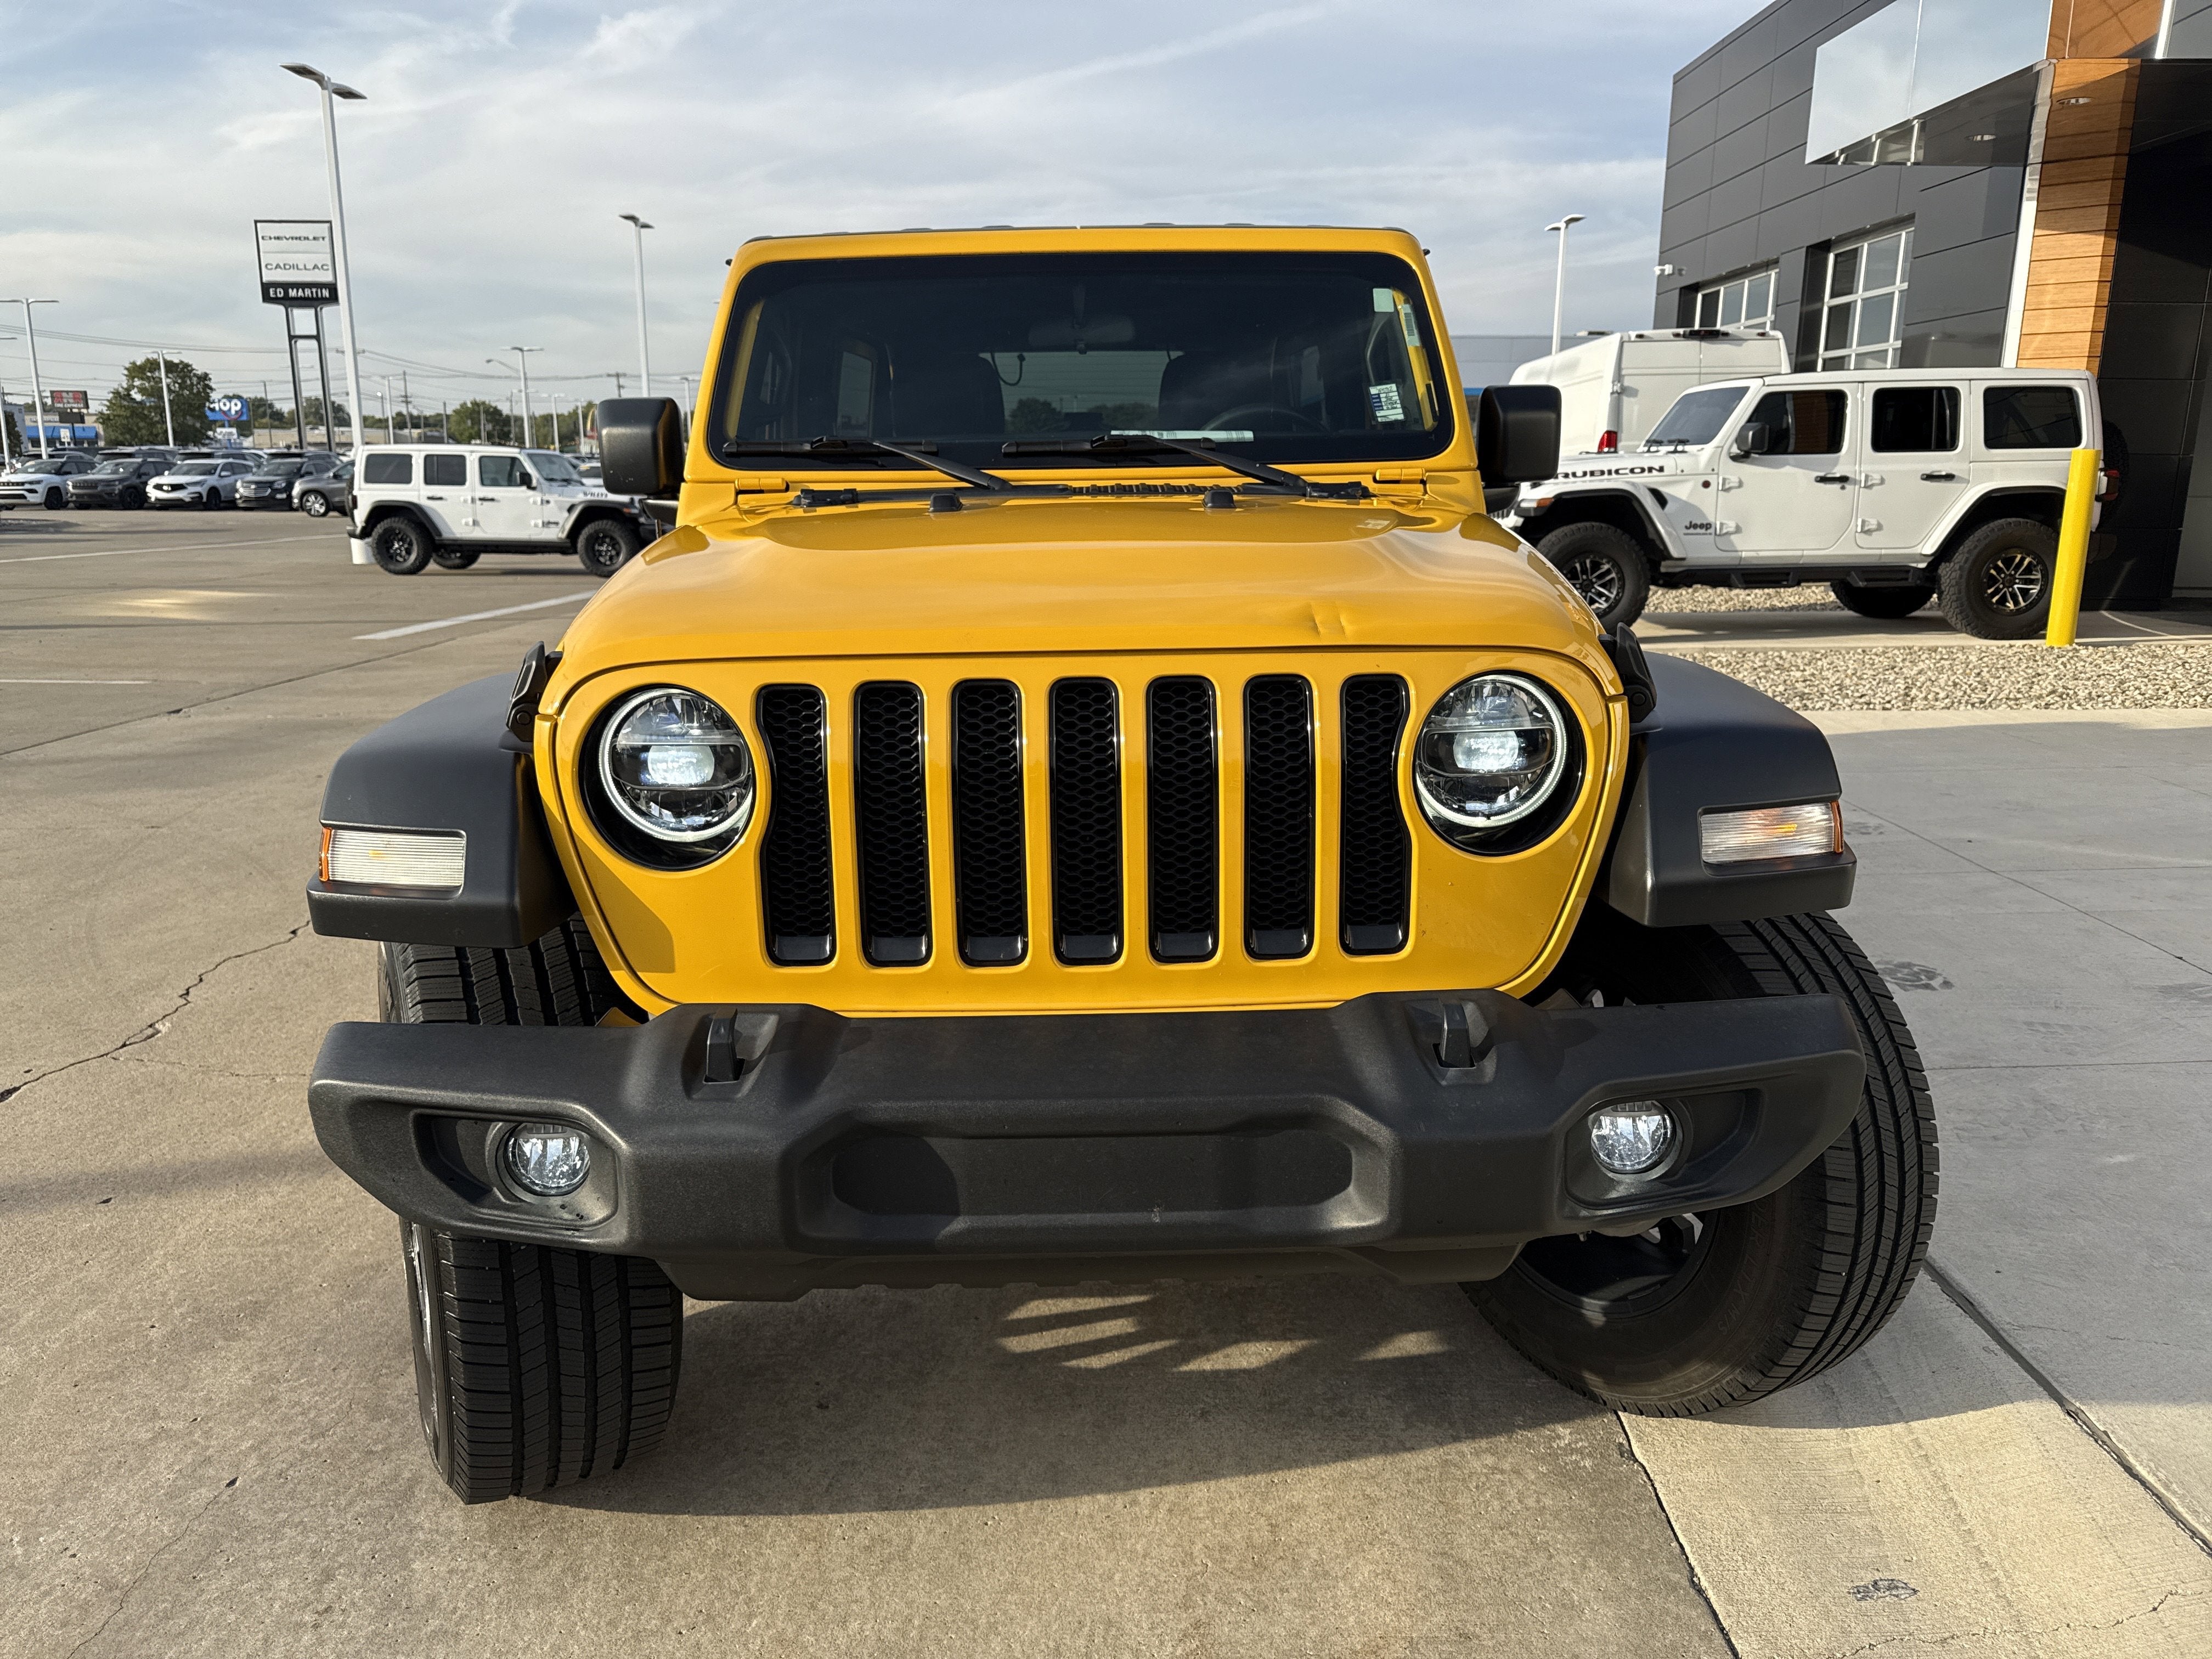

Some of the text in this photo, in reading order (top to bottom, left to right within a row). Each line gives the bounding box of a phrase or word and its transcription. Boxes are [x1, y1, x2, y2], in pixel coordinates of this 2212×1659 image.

[265, 263, 329, 271] CADILLAC
[269, 287, 329, 298] ED MARTIN
[1554, 465, 1664, 479] RUBICON
[1685, 520, 1712, 532] Jeep
